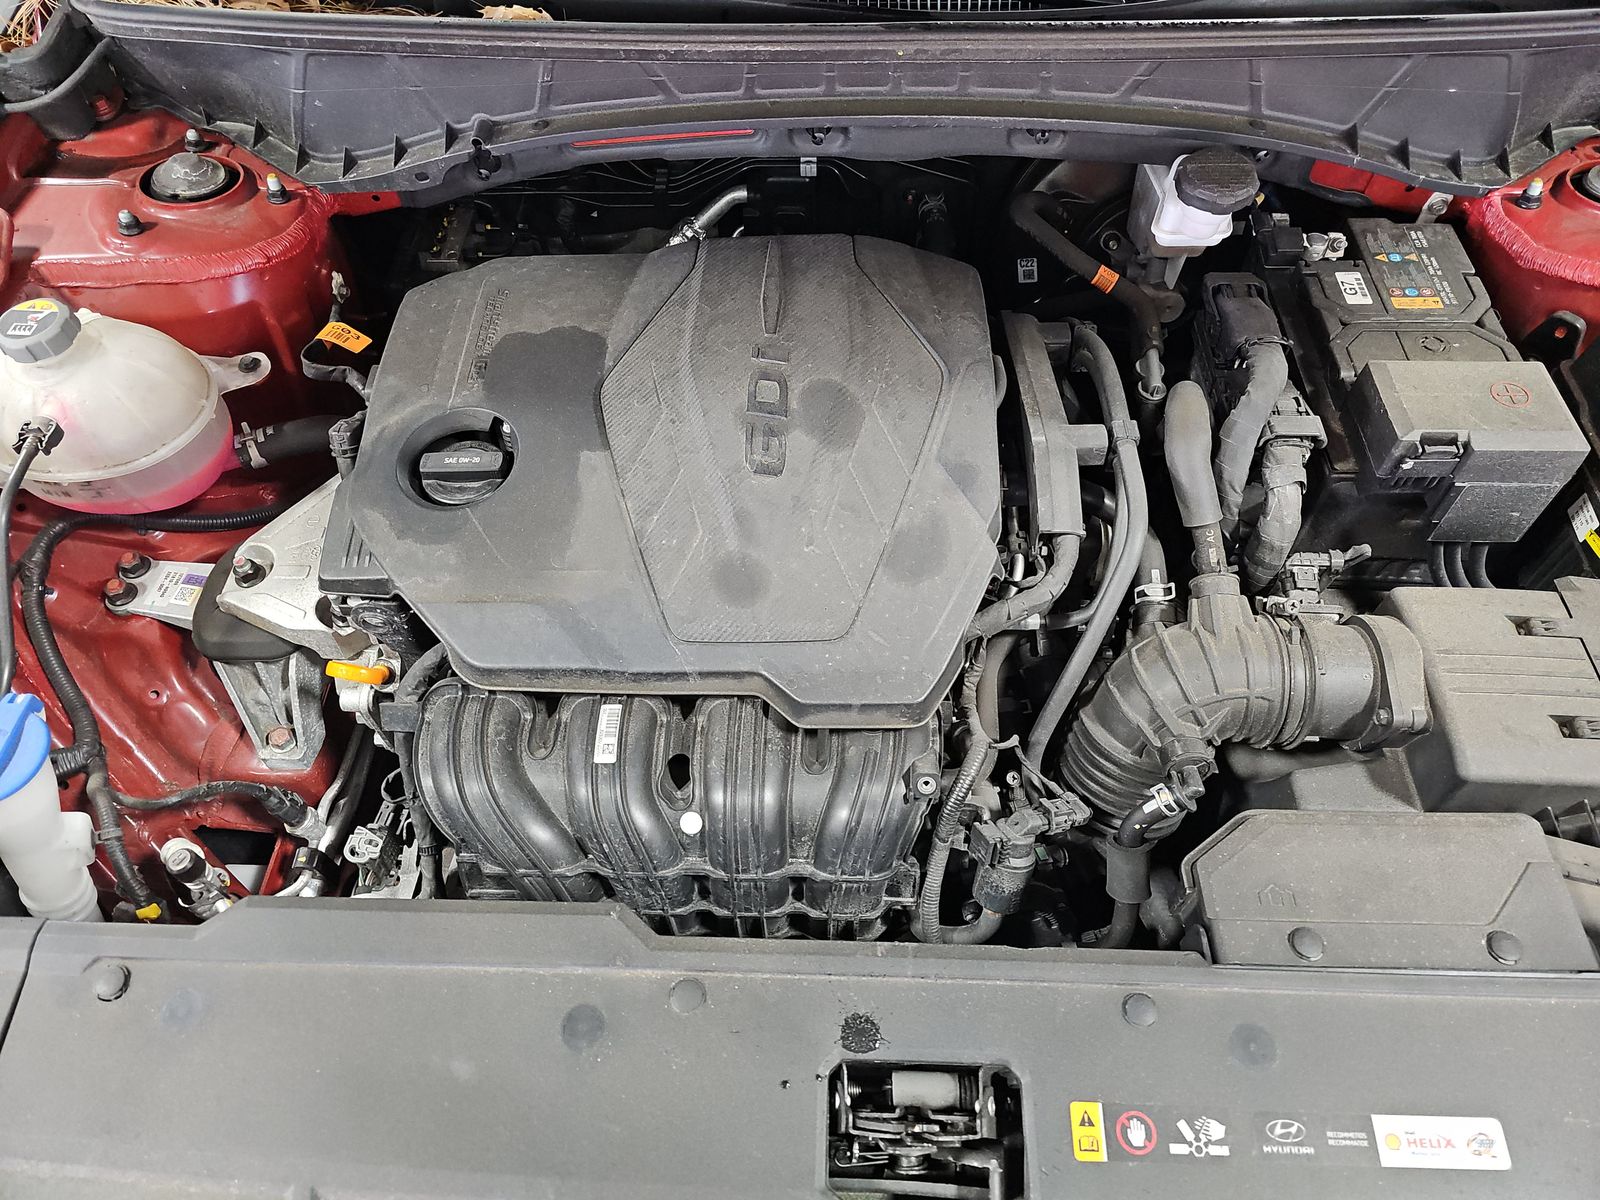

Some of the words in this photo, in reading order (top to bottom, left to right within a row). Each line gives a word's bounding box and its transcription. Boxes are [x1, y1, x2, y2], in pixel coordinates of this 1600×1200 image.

[1340, 280, 1358, 296] G7
[1205, 529, 1215, 543] AC
[1262, 1144, 1315, 1155] HYUNDAI
[1406, 1137, 1457, 1149] HELIX
